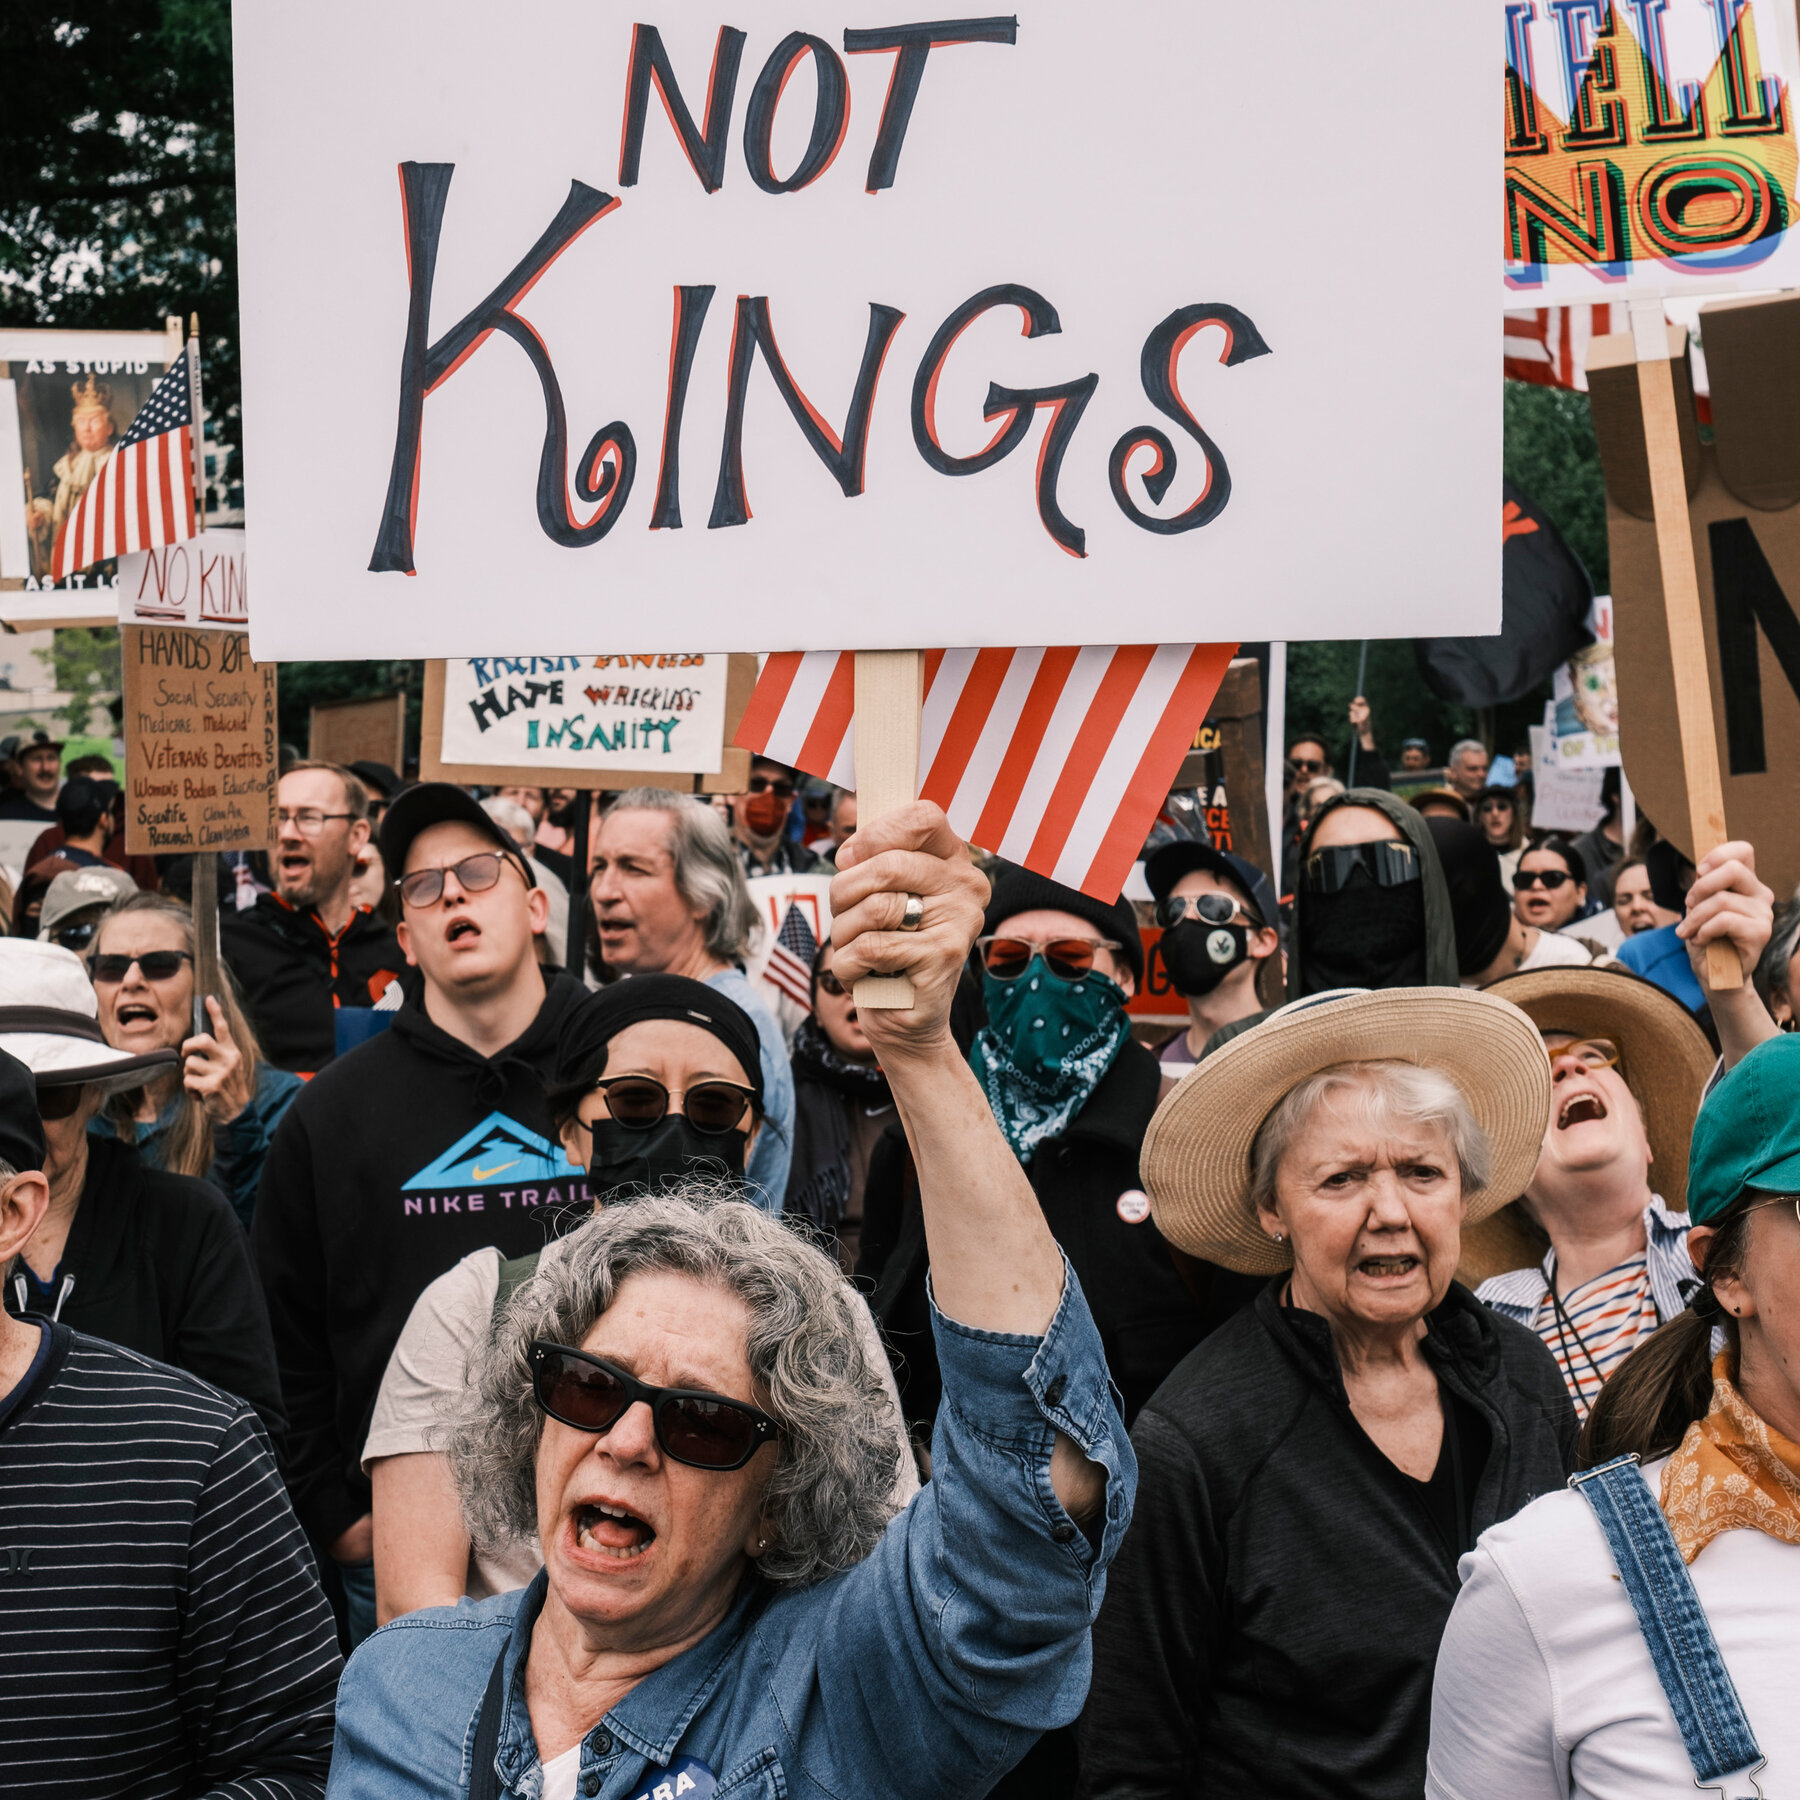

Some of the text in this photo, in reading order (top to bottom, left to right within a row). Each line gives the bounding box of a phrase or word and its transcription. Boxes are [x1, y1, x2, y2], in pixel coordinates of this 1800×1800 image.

[618, 15, 1020, 195] NOT
[1504, 149, 1789, 290] NO
[25, 359, 149, 375] AS STUPID
[367, 160, 1273, 577] KINGS
[25, 574, 55, 592] AS
[65, 574, 87, 591] IT
[138, 545, 249, 614] NO KIN
[139, 629, 211, 671] HANDS
[153, 678, 257, 723] Social Security
[468, 680, 564, 733] HATE
[526, 713, 680, 753] INSANITY
[404, 1184, 596, 1216] NIKE TRAIL
